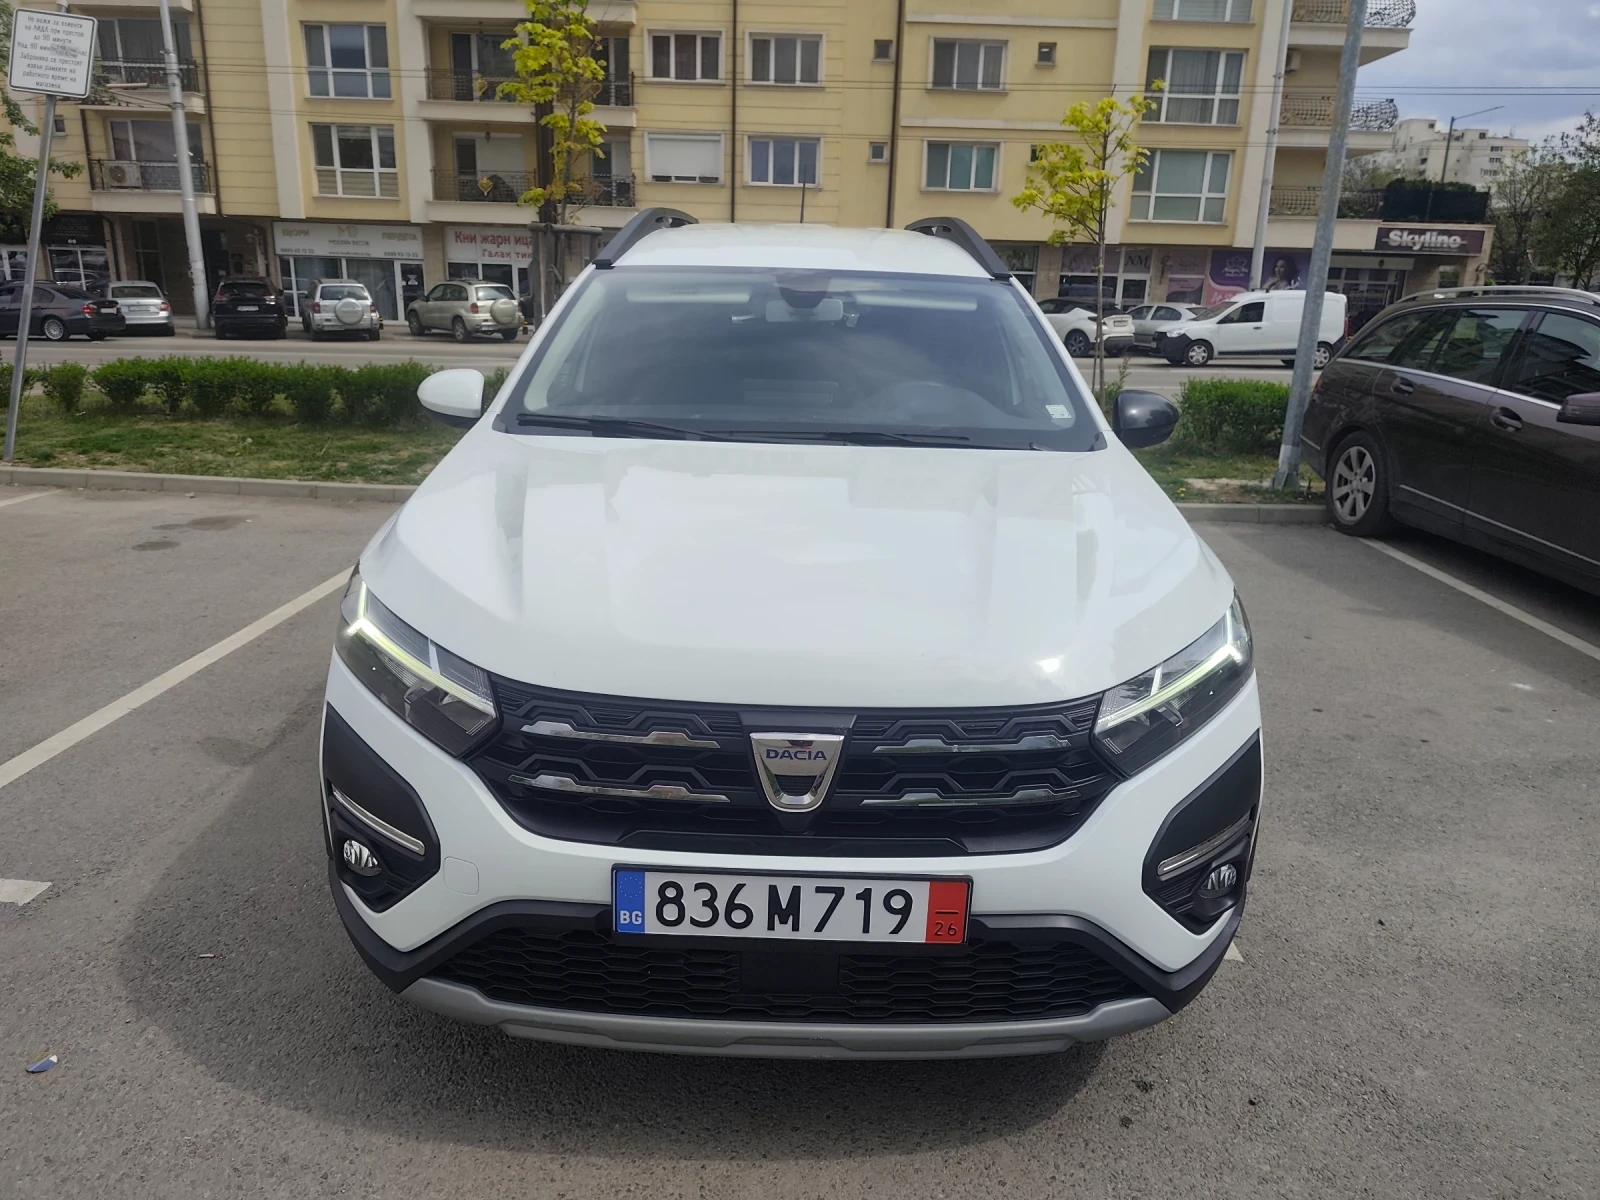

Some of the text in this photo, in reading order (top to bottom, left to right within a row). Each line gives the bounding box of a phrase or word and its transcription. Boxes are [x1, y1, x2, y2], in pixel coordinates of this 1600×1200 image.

[766, 749, 827, 760] DACIA
[655, 880, 754, 929] 836
[813, 885, 913, 935] 719
[620, 910, 642, 925] BG
[935, 922, 957, 936] 26
